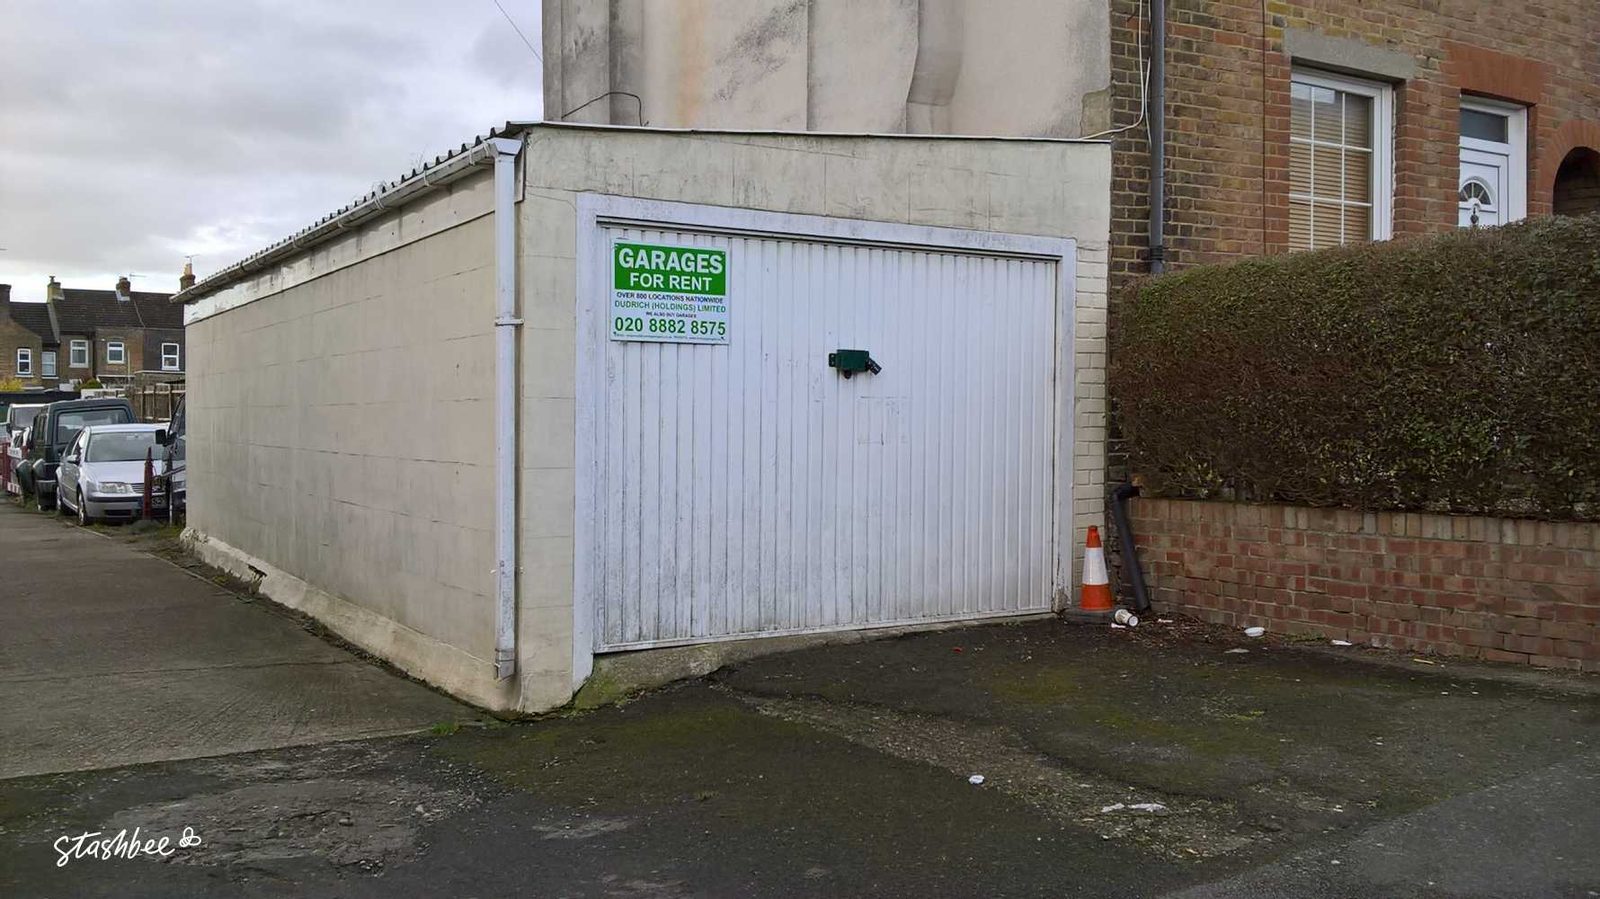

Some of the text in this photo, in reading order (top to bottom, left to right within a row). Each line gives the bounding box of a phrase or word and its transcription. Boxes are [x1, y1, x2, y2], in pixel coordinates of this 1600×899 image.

[618, 248, 723, 274] GARAGES
[630, 273, 712, 291] FOR RENT
[615, 300, 726, 313] DUDRICH (HOLDINGS) LIMITED
[648, 294, 684, 302] LOCATIONS
[685, 296, 723, 304] NATIONWIDE
[615, 317, 726, 336] 020 8882 8575
